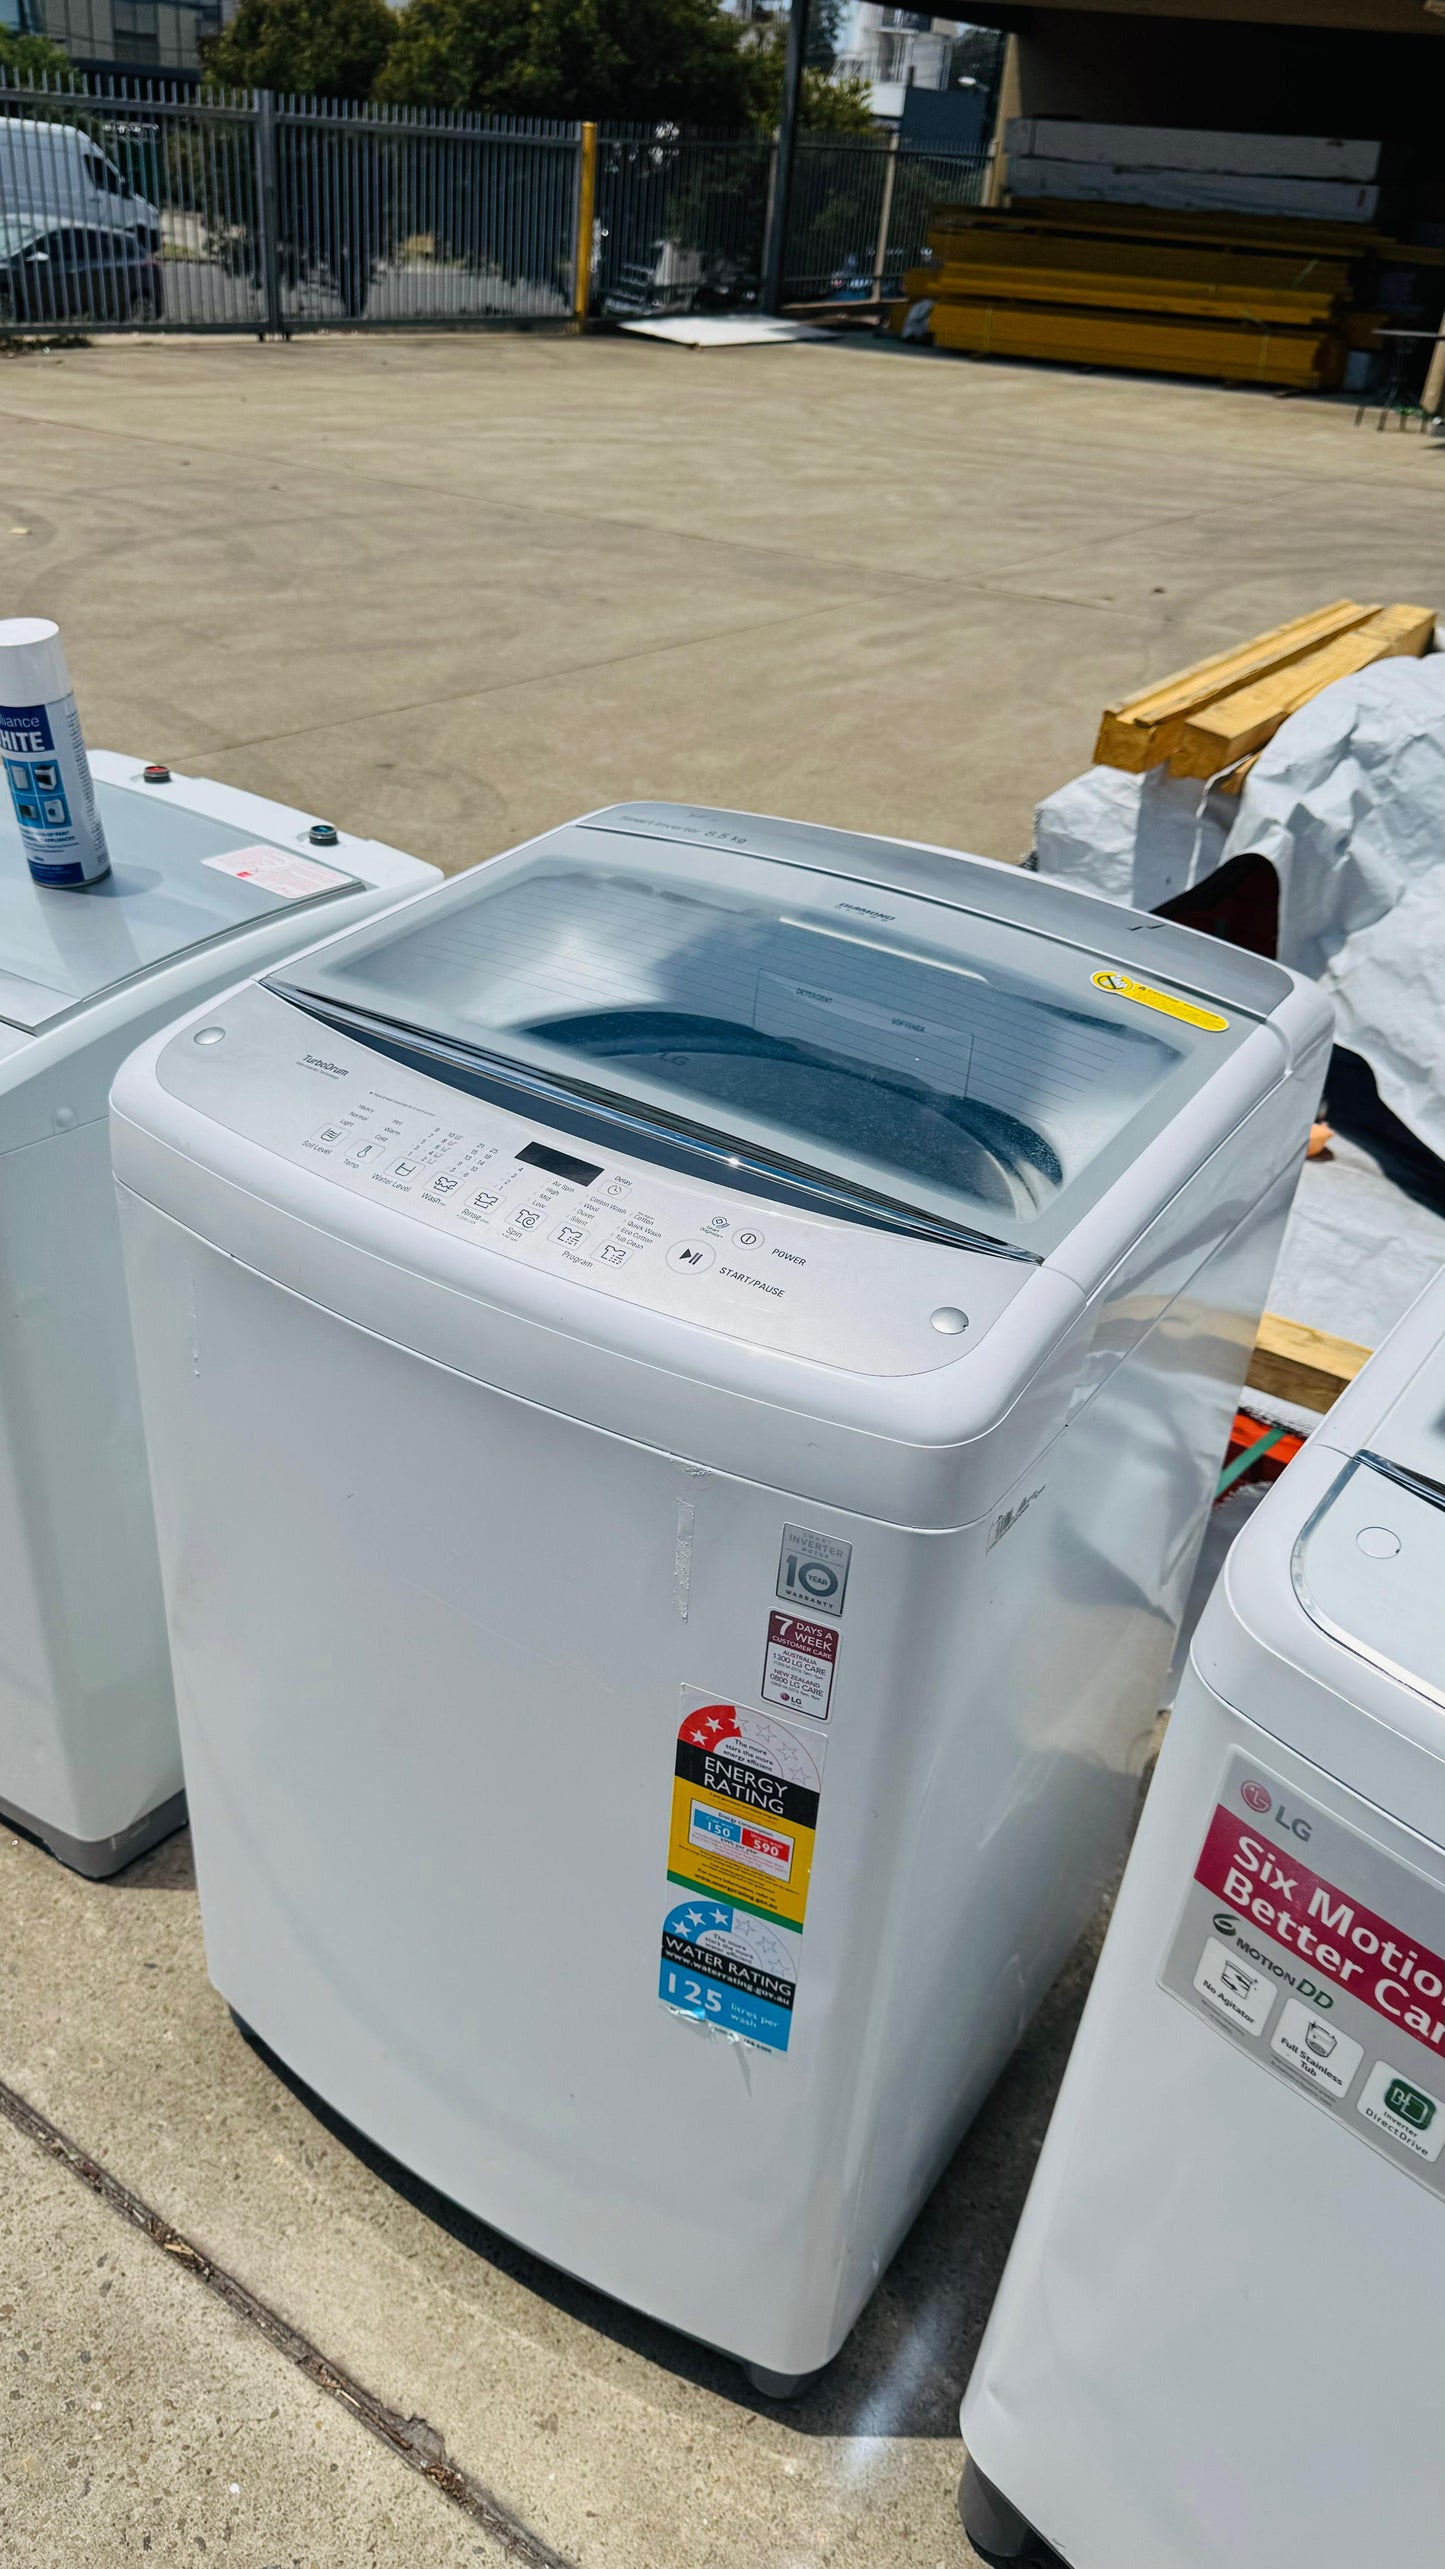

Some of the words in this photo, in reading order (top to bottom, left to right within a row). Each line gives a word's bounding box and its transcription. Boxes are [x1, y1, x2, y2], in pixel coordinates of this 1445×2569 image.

[0, 713, 39, 727] liance
[0, 729, 45, 751] HITE
[796, 988, 833, 1005] DETERGENT
[891, 1017, 926, 1034] SOFTENER
[303, 1054, 349, 1077] TurboDrum
[340, 1118, 355, 1128] Light
[349, 1111, 370, 1121] Normal
[374, 1134, 389, 1143] Cold
[384, 1126, 401, 1136] Warm
[302, 1139, 314, 1150] Soil
[313, 1143, 333, 1156] Level
[343, 1158, 360, 1169] Temp
[371, 1173, 393, 1186] Water
[392, 1180, 413, 1193] Level
[561, 1184, 575, 1193] Spin
[614, 1175, 633, 1187] Delay
[421, 1192, 441, 1205] Wash
[539, 1193, 552, 1202] Mid
[545, 1187, 560, 1196] High
[532, 1200, 546, 1208] Low
[583, 1202, 600, 1213] Wool
[589, 1195, 610, 1208] Cotton
[609, 1203, 627, 1215] Wash
[461, 1208, 481, 1221] Rinse
[570, 1215, 589, 1227] Silent
[576, 1208, 595, 1220] Duvet
[633, 1213, 654, 1226] Cotton
[505, 1226, 523, 1238] Spin
[620, 1227, 633, 1236] Eco
[632, 1231, 653, 1244] Cotton
[626, 1220, 643, 1232] Quick
[644, 1227, 662, 1239] Wash
[615, 1234, 627, 1243] Tub
[626, 1239, 644, 1250] Clean
[561, 1250, 594, 1268] Program
[771, 1248, 807, 1266] POWER
[719, 1266, 786, 1298] START/PAUSE
[789, 1534, 844, 1558] INVERTER
[785, 1554, 839, 1597] 10
[807, 1574, 828, 1586] YEAR
[785, 1589, 834, 1609] WARRANTY
[774, 1614, 793, 1636] 7
[796, 1622, 823, 1637] DAYS
[824, 1632, 833, 1641] A
[772, 1635, 812, 1653] CUSTOMER
[812, 1648, 833, 1660] CARE
[794, 1631, 832, 1652] WEEK
[772, 1652, 791, 1664] 1300
[791, 1659, 803, 1669] LG
[804, 1663, 827, 1677] CARE
[782, 1650, 817, 1666] AUSTRALIA
[769, 1673, 789, 1685] 0800
[789, 1680, 800, 1689] LG
[801, 1684, 824, 1697] CARE
[773, 1668, 790, 1677] NEW
[790, 1674, 821, 1688] ZEALAND
[790, 1696, 802, 1705] LG
[725, 1744, 741, 1753] stars
[742, 1750, 754, 1758] the
[755, 1755, 774, 1766] more
[734, 1738, 748, 1748] The
[748, 1745, 768, 1756] more
[723, 1750, 745, 1762] energy
[746, 1758, 773, 1772] efficient
[704, 1756, 788, 1798] ENERGY
[704, 1772, 784, 1815] RATING
[718, 1812, 737, 1824] Energy
[1275, 1805, 1313, 1842] LG
[707, 1821, 730, 1838] 150
[720, 1837, 735, 1846] kWh
[735, 1843, 745, 1851] per
[753, 1839, 780, 1857] 590
[1223, 1866, 1364, 1982] Better
[1233, 1835, 1298, 1902] Six
[1307, 1887, 1445, 2006] Motio
[705, 1937, 721, 1946] stars
[722, 1943, 734, 1951] the
[735, 1949, 754, 1959] more
[714, 1933, 726, 1943] The
[727, 1940, 747, 1951] more
[665, 1935, 723, 1969] WATER
[728, 1962, 792, 1997] RATING
[1236, 1937, 1296, 1986] MOTION
[664, 1949, 791, 2006] www.waterrating.gov.au
[668, 1972, 723, 2013] 125
[1202, 1980, 1217, 1994] No
[1217, 1993, 1256, 2024] Agitator
[730, 2002, 758, 2020] litres
[760, 2016, 779, 2028] per
[730, 2013, 757, 2029] wash
[1281, 2037, 1299, 2053] Full
[1299, 2050, 1344, 2086] Stainless
[1300, 2060, 1317, 2076] Tub
[1365, 2108, 1429, 2156] DirectDrive
[1383, 2111, 1418, 2138] Inverter
